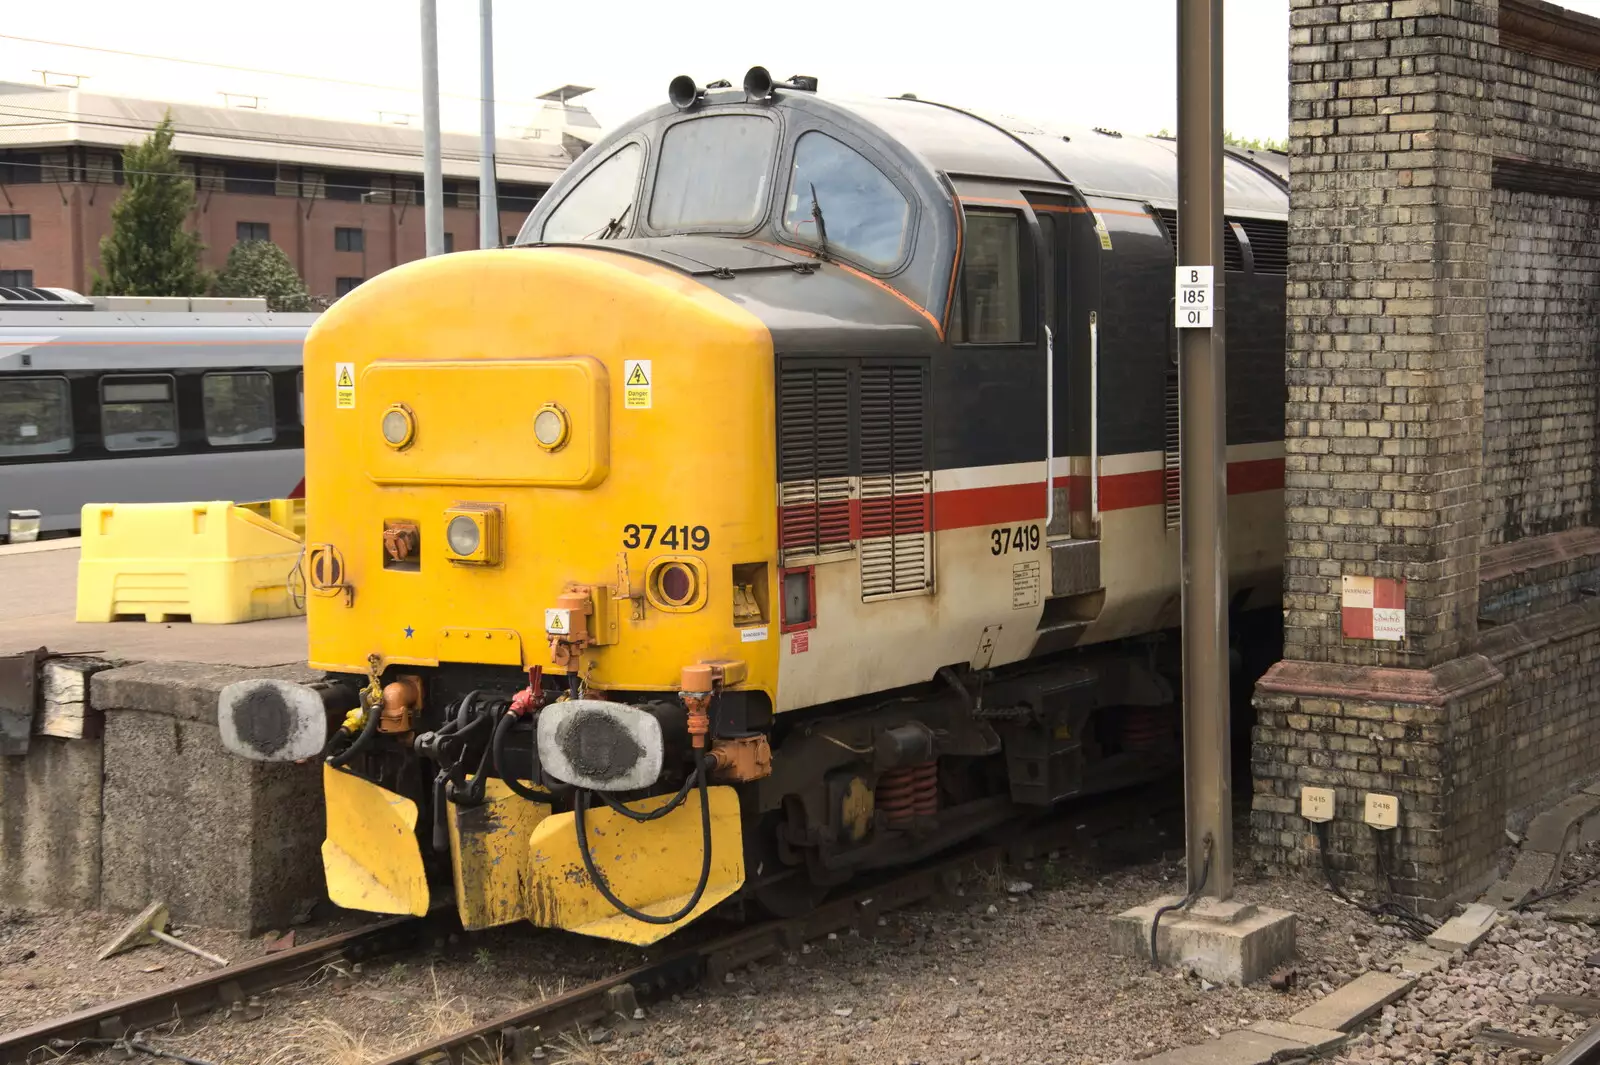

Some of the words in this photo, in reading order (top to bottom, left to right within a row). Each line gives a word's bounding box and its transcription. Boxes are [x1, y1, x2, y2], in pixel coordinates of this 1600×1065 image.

[1191, 270, 1199, 283] B
[1183, 290, 1205, 304] 185
[1187, 311, 1201, 324] 01
[628, 390, 648, 398] Danger
[623, 523, 711, 552] 37419
[990, 524, 1040, 556] 37419
[1308, 795, 1326, 803] 2415
